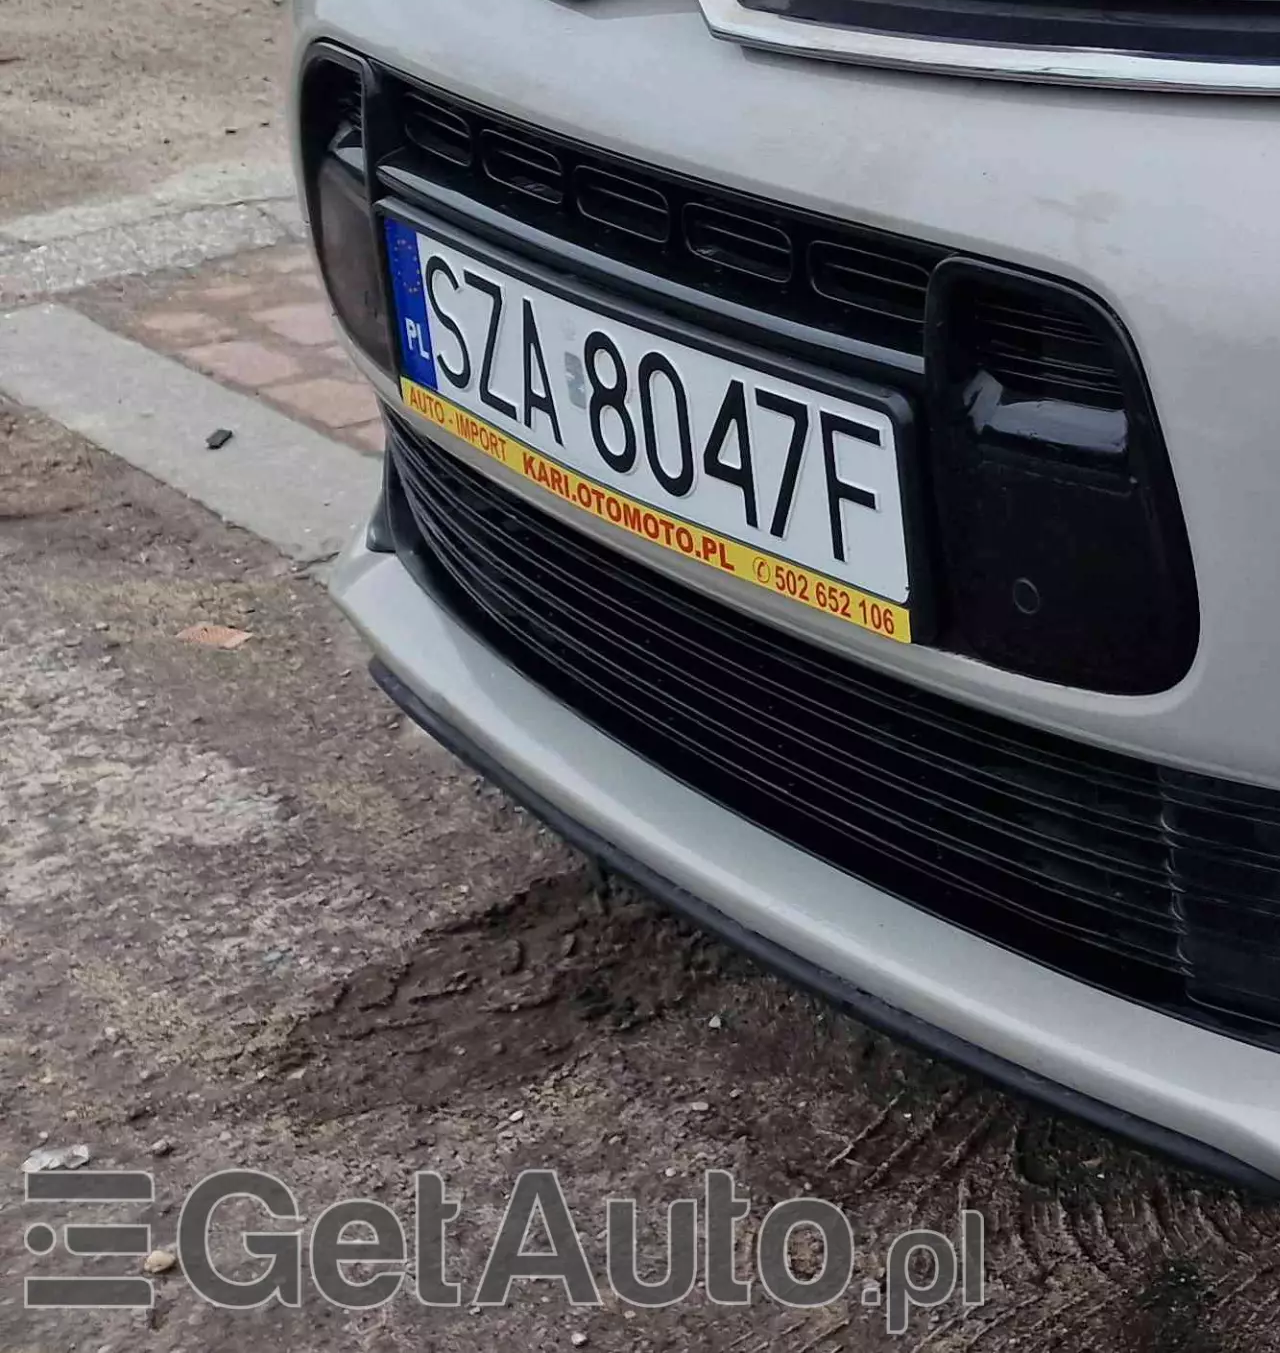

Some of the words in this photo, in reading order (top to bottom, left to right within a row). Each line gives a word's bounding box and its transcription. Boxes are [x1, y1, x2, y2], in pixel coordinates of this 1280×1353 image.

[405, 317, 430, 360] PL
[425, 255, 565, 447] SZA
[584, 330, 881, 562] 8047F
[409, 387, 445, 425] AUTO
[455, 411, 507, 462] IMPORT
[523, 451, 735, 572] KARI.OTOMOTO.PL
[775, 564, 810, 602] 502
[815, 581, 852, 618] 652
[858, 599, 895, 635] 106
